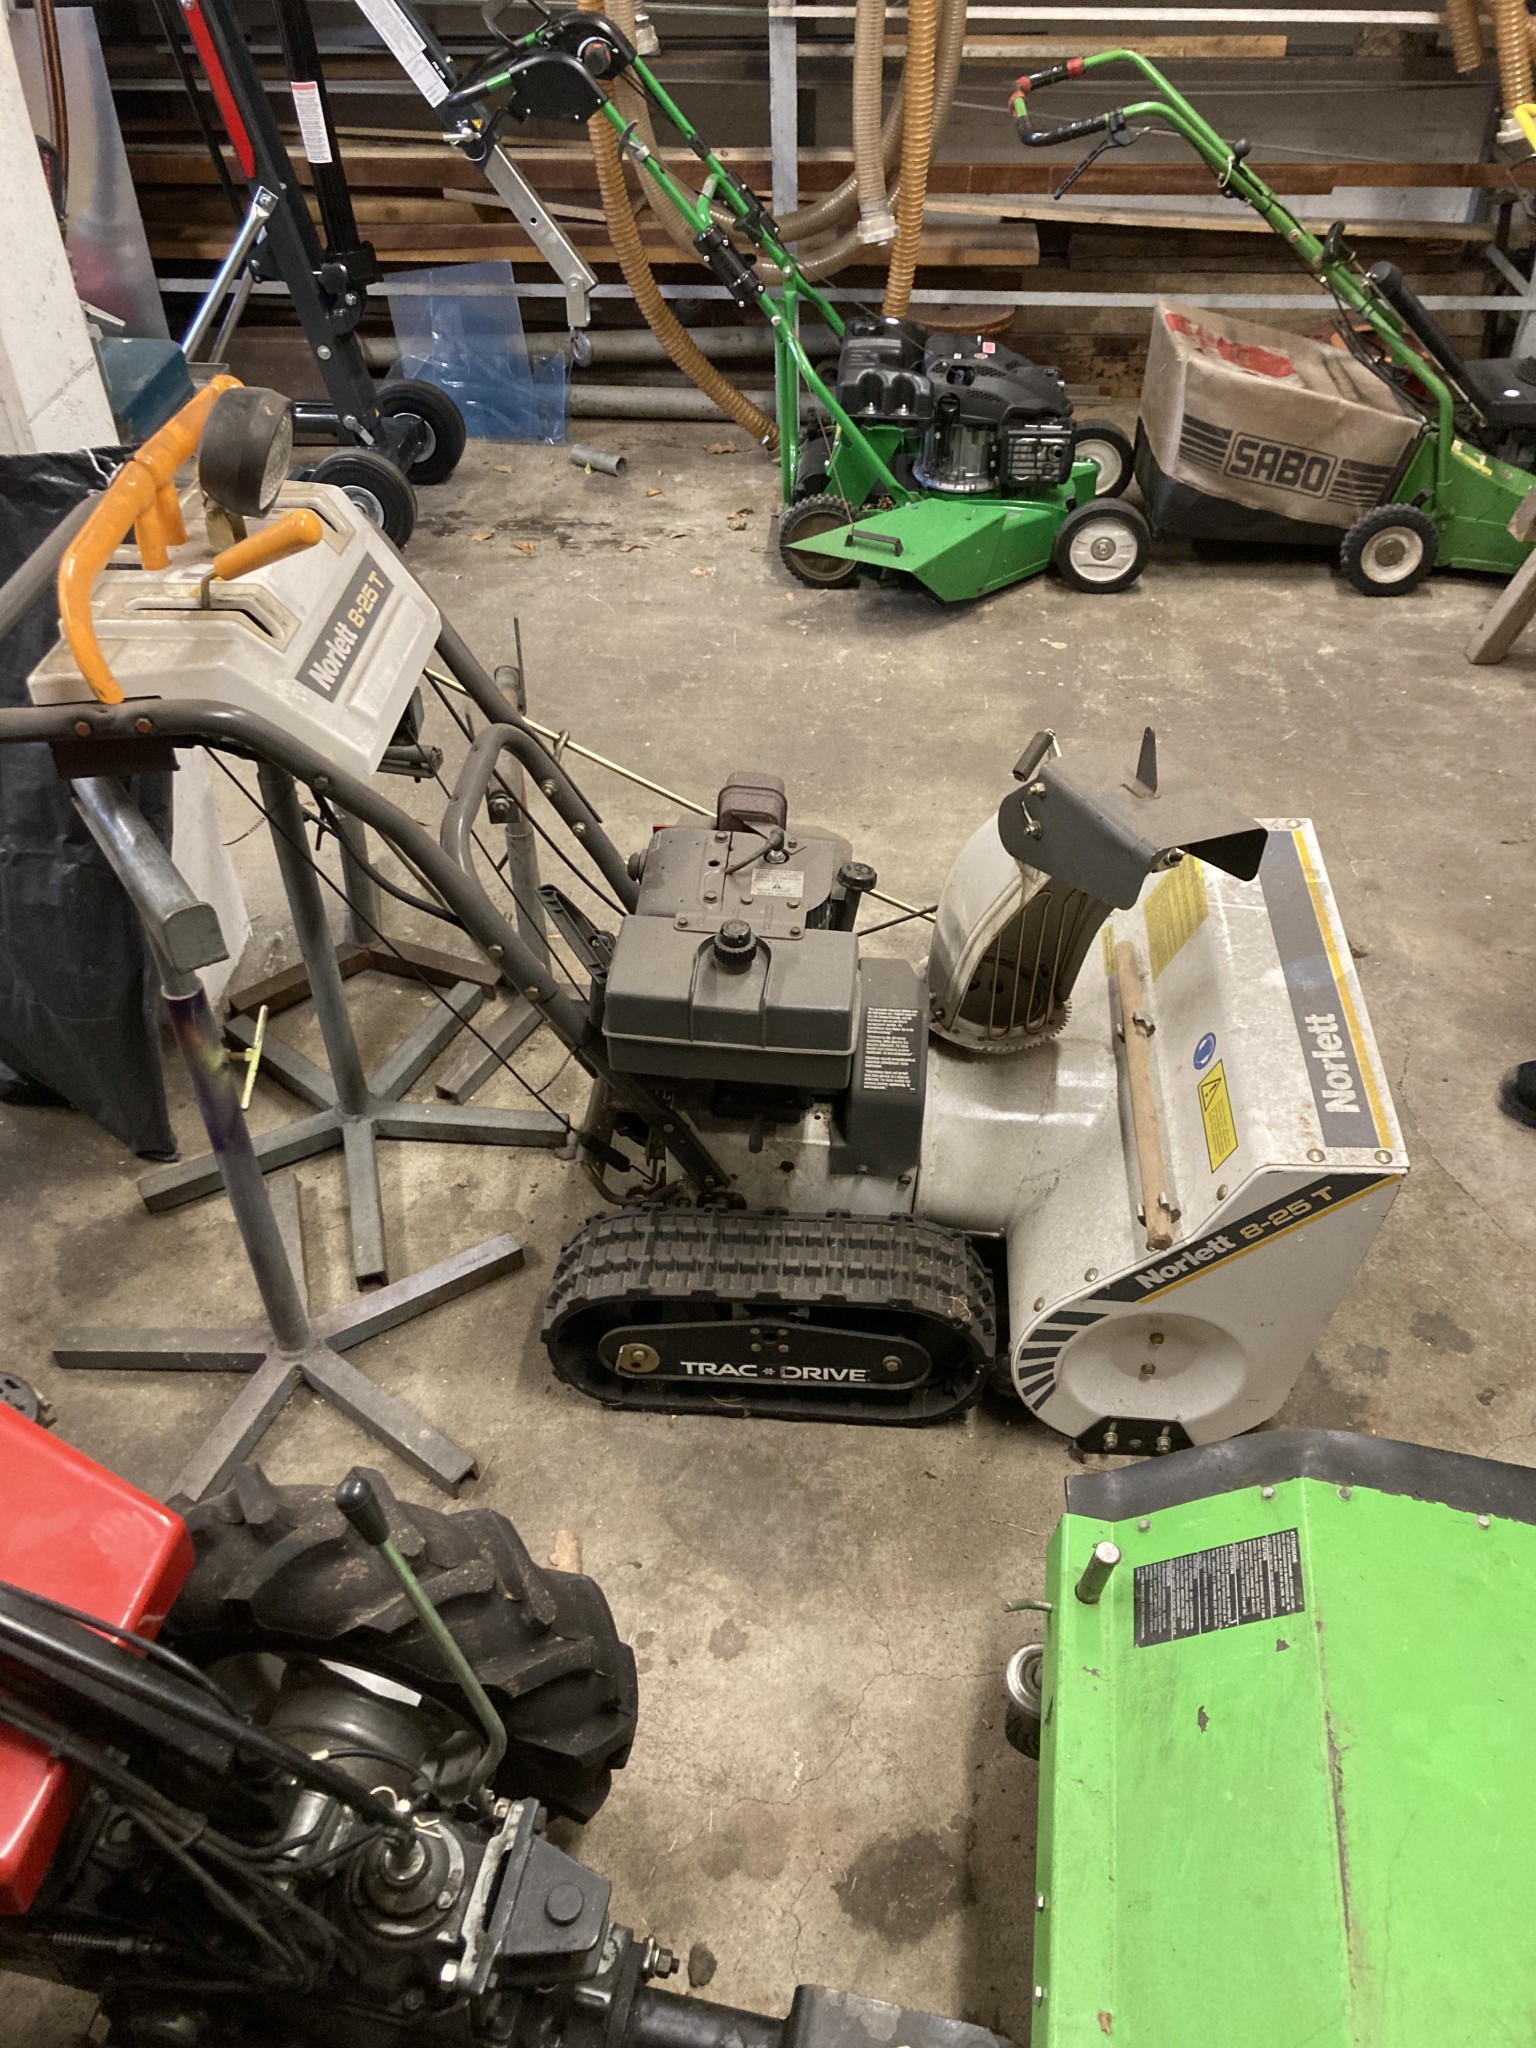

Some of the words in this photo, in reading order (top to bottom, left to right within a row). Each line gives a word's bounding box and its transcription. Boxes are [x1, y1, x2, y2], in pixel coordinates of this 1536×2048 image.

[1230, 439, 1331, 493] SABO
[308, 621, 359, 692] Norlett
[347, 583, 380, 629] 8-25
[368, 570, 385, 589] T
[1304, 1013, 1361, 1113] Norlett
[1134, 1234, 1237, 1290] Norlett
[1239, 1198, 1313, 1240] 8-25
[1311, 1185, 1333, 1202] T
[680, 1361, 758, 1378] TRAC
[780, 1365, 867, 1383] DRIVE
